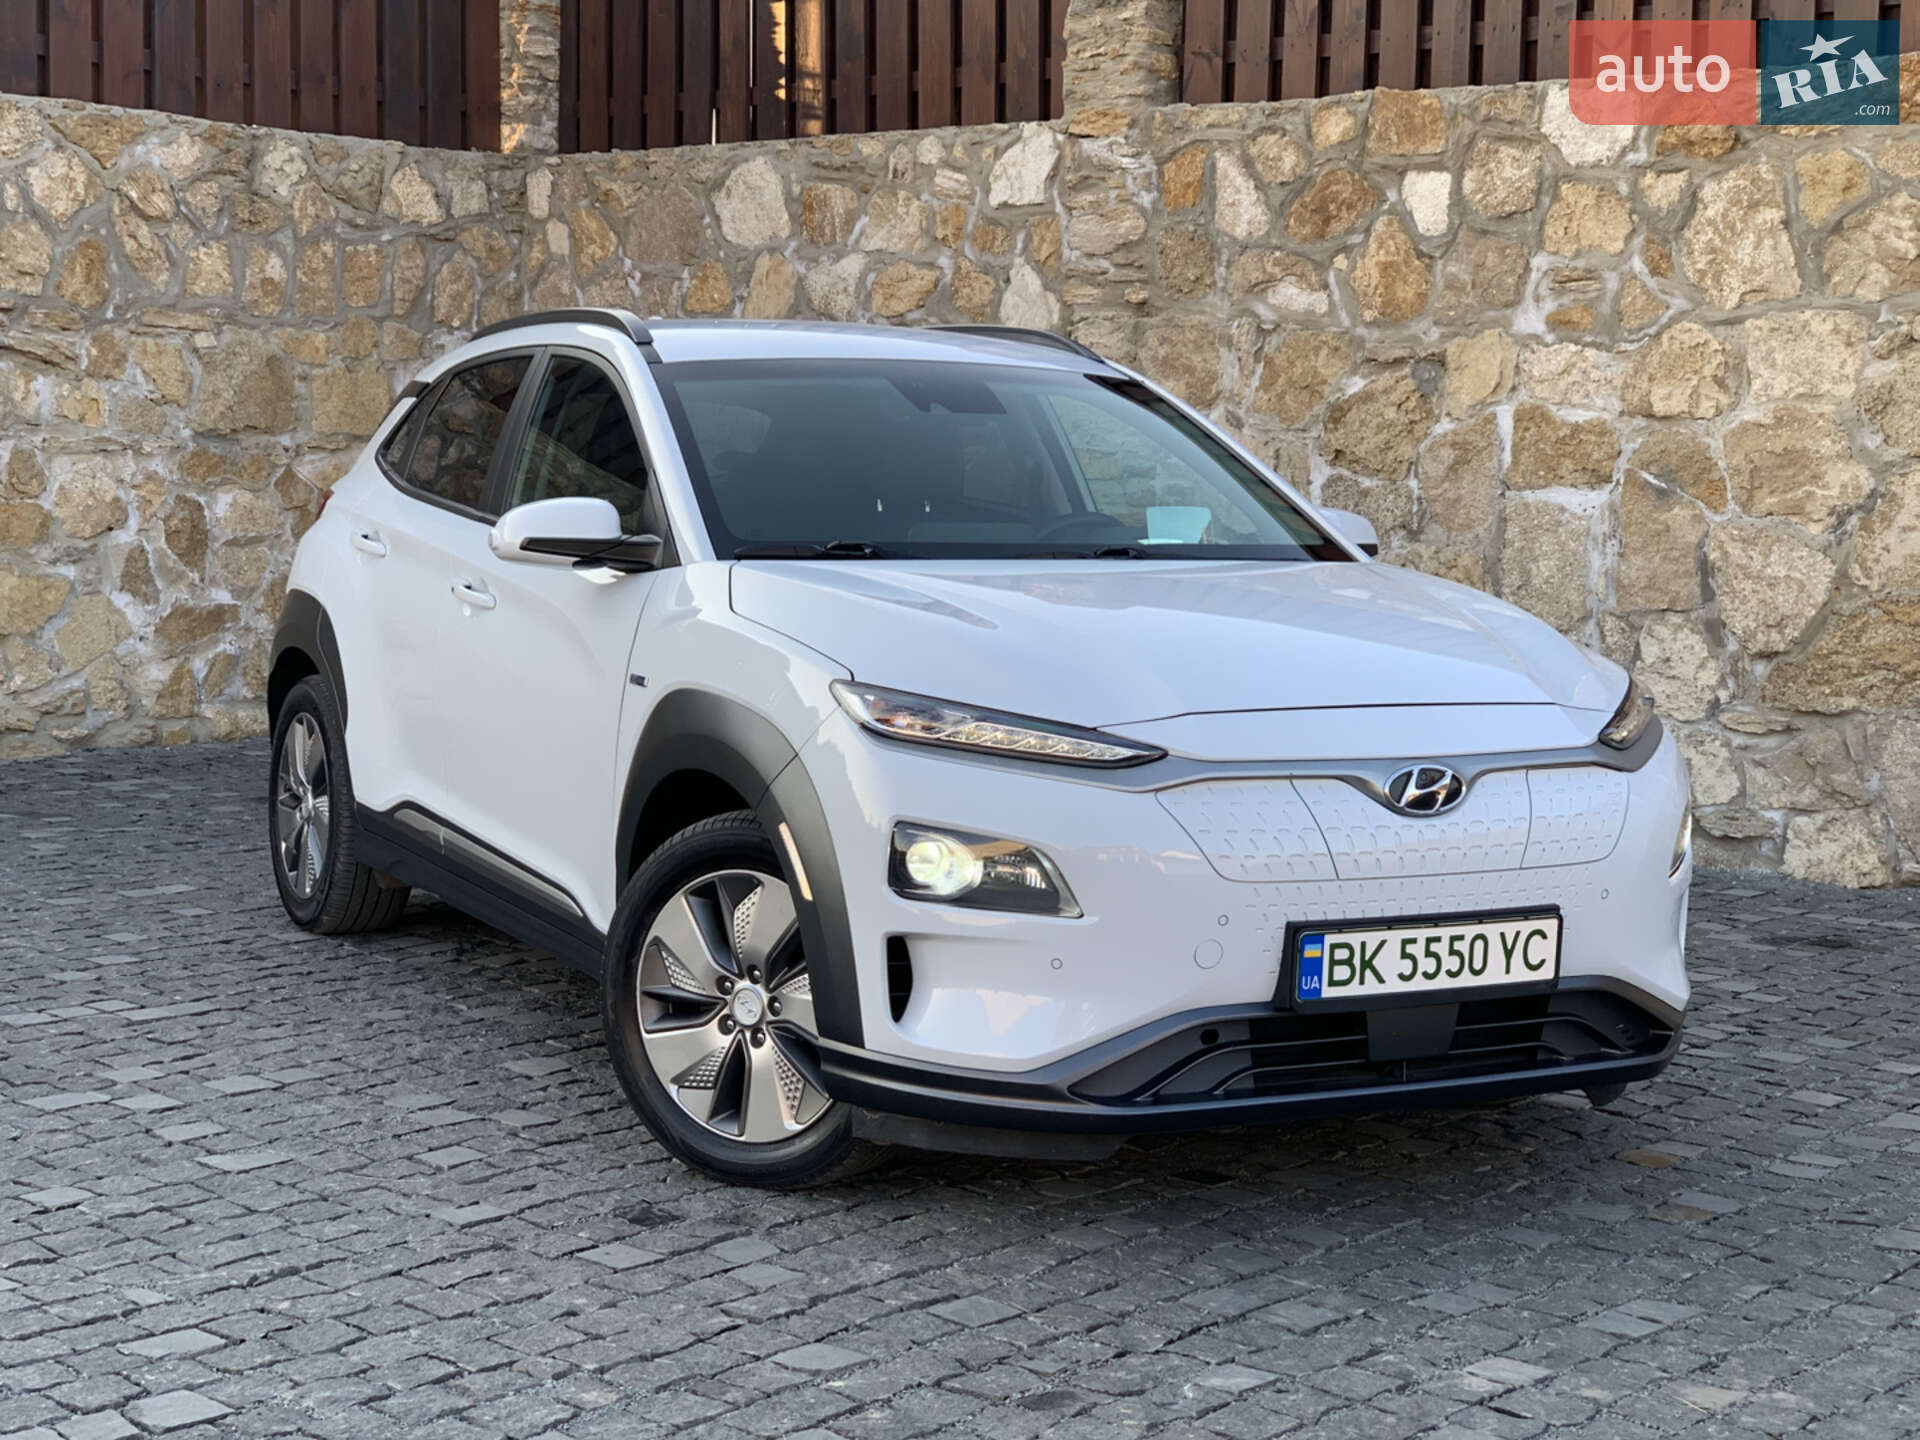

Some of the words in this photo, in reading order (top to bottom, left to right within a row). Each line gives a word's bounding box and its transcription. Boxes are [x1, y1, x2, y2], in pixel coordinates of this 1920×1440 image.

[1327, 939, 1388, 988] BK
[1397, 933, 1489, 982] 5550
[1499, 928, 1548, 975] YC
[1302, 975, 1320, 990] UA
